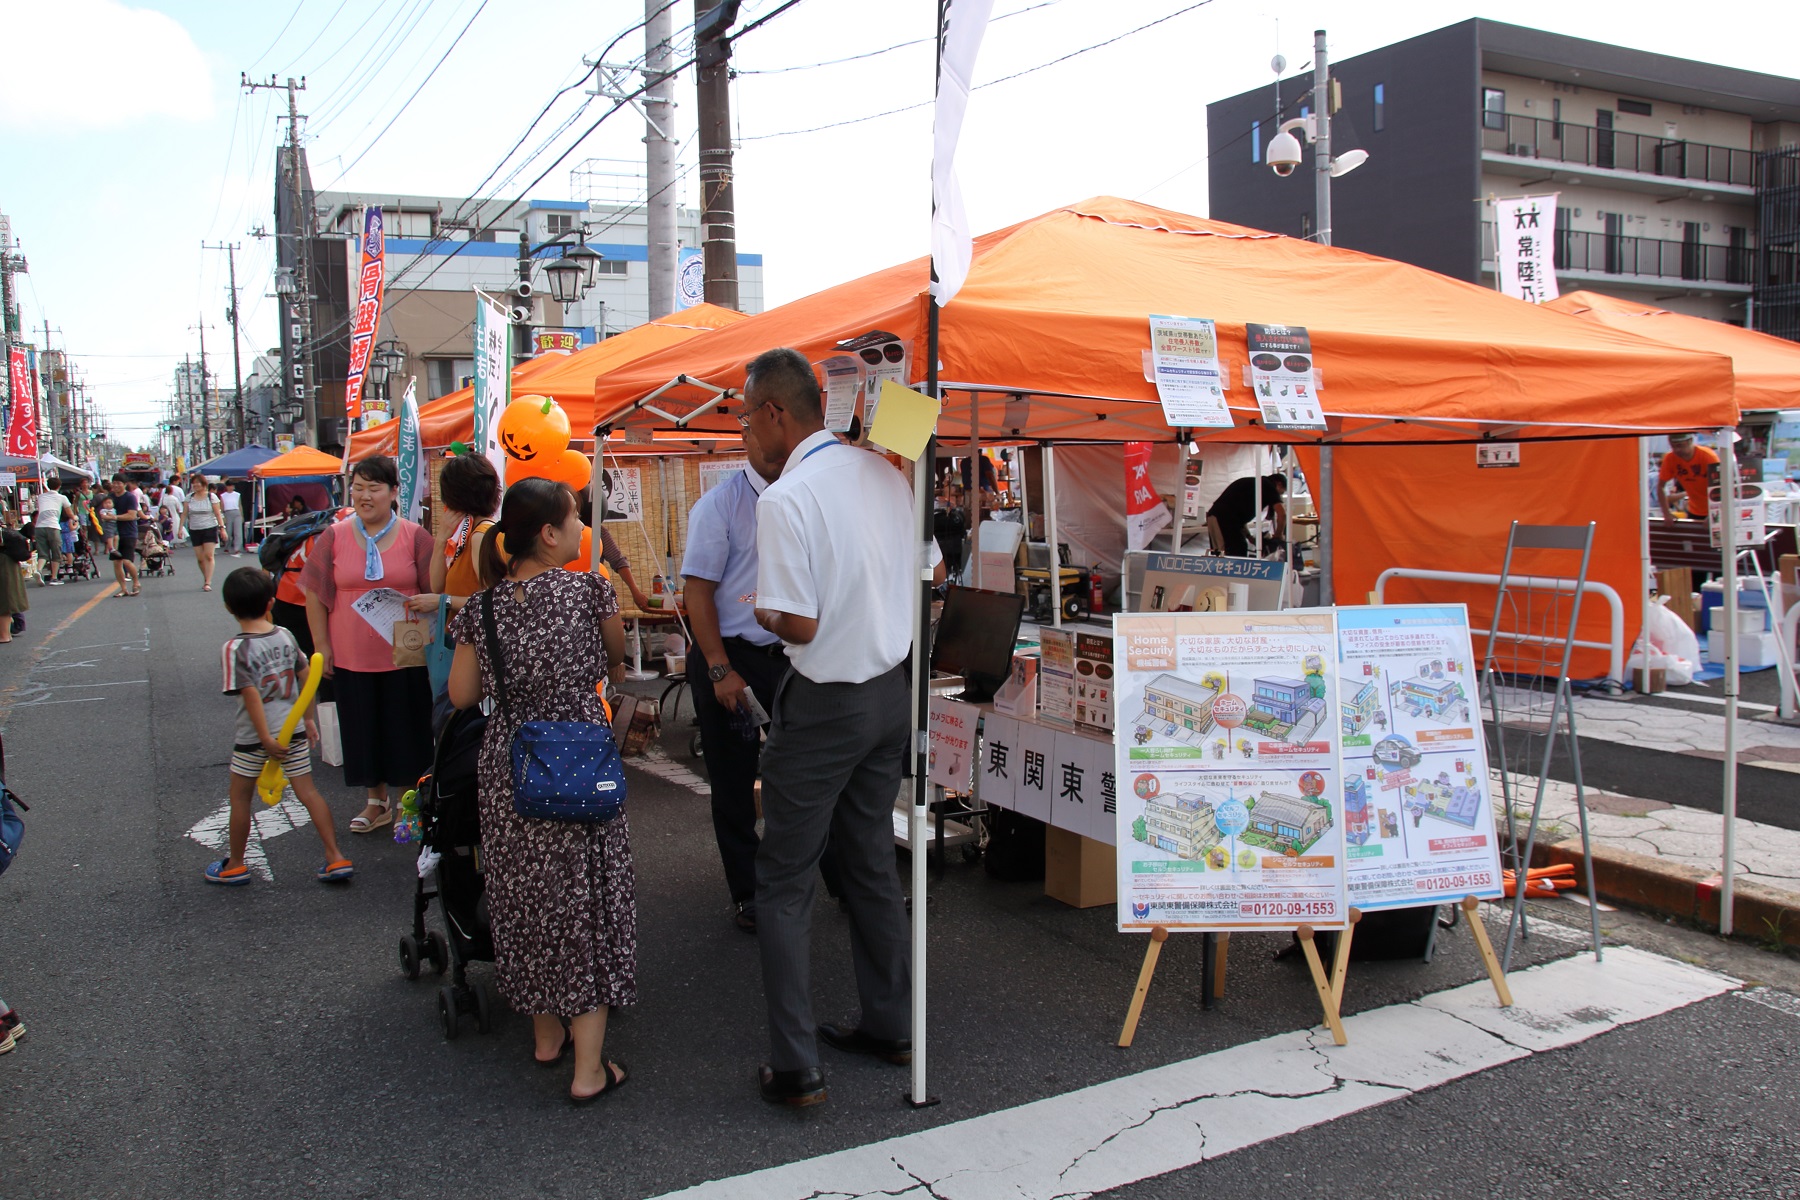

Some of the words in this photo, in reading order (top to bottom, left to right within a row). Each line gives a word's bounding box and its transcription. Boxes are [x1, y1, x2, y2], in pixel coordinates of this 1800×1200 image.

[540, 335, 574, 350] 歓迎
[1214, 562, 1272, 579] セキュリティ
[1134, 635, 1168, 645] Home
[1128, 646, 1174, 657] Security
[261, 668, 294, 704] 27
[1426, 873, 1491, 890] 0120-09-1553
[1254, 902, 1335, 916] 0120-09-1553
